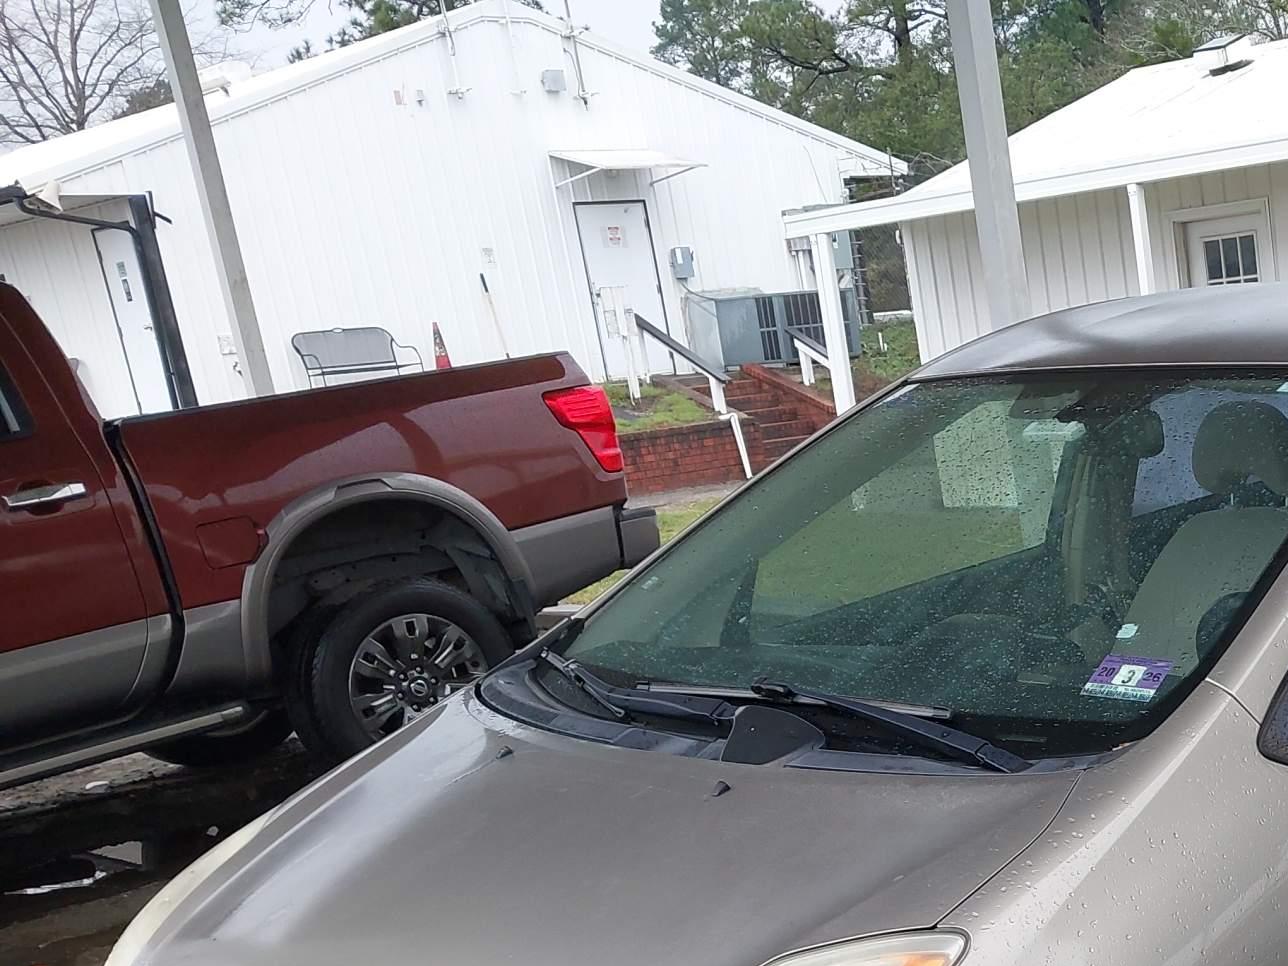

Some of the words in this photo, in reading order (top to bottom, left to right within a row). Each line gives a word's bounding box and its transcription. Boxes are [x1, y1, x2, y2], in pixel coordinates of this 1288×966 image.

[1097, 666, 1116, 678] 20
[1121, 669, 1136, 684] 3
[1142, 671, 1163, 683] 26
